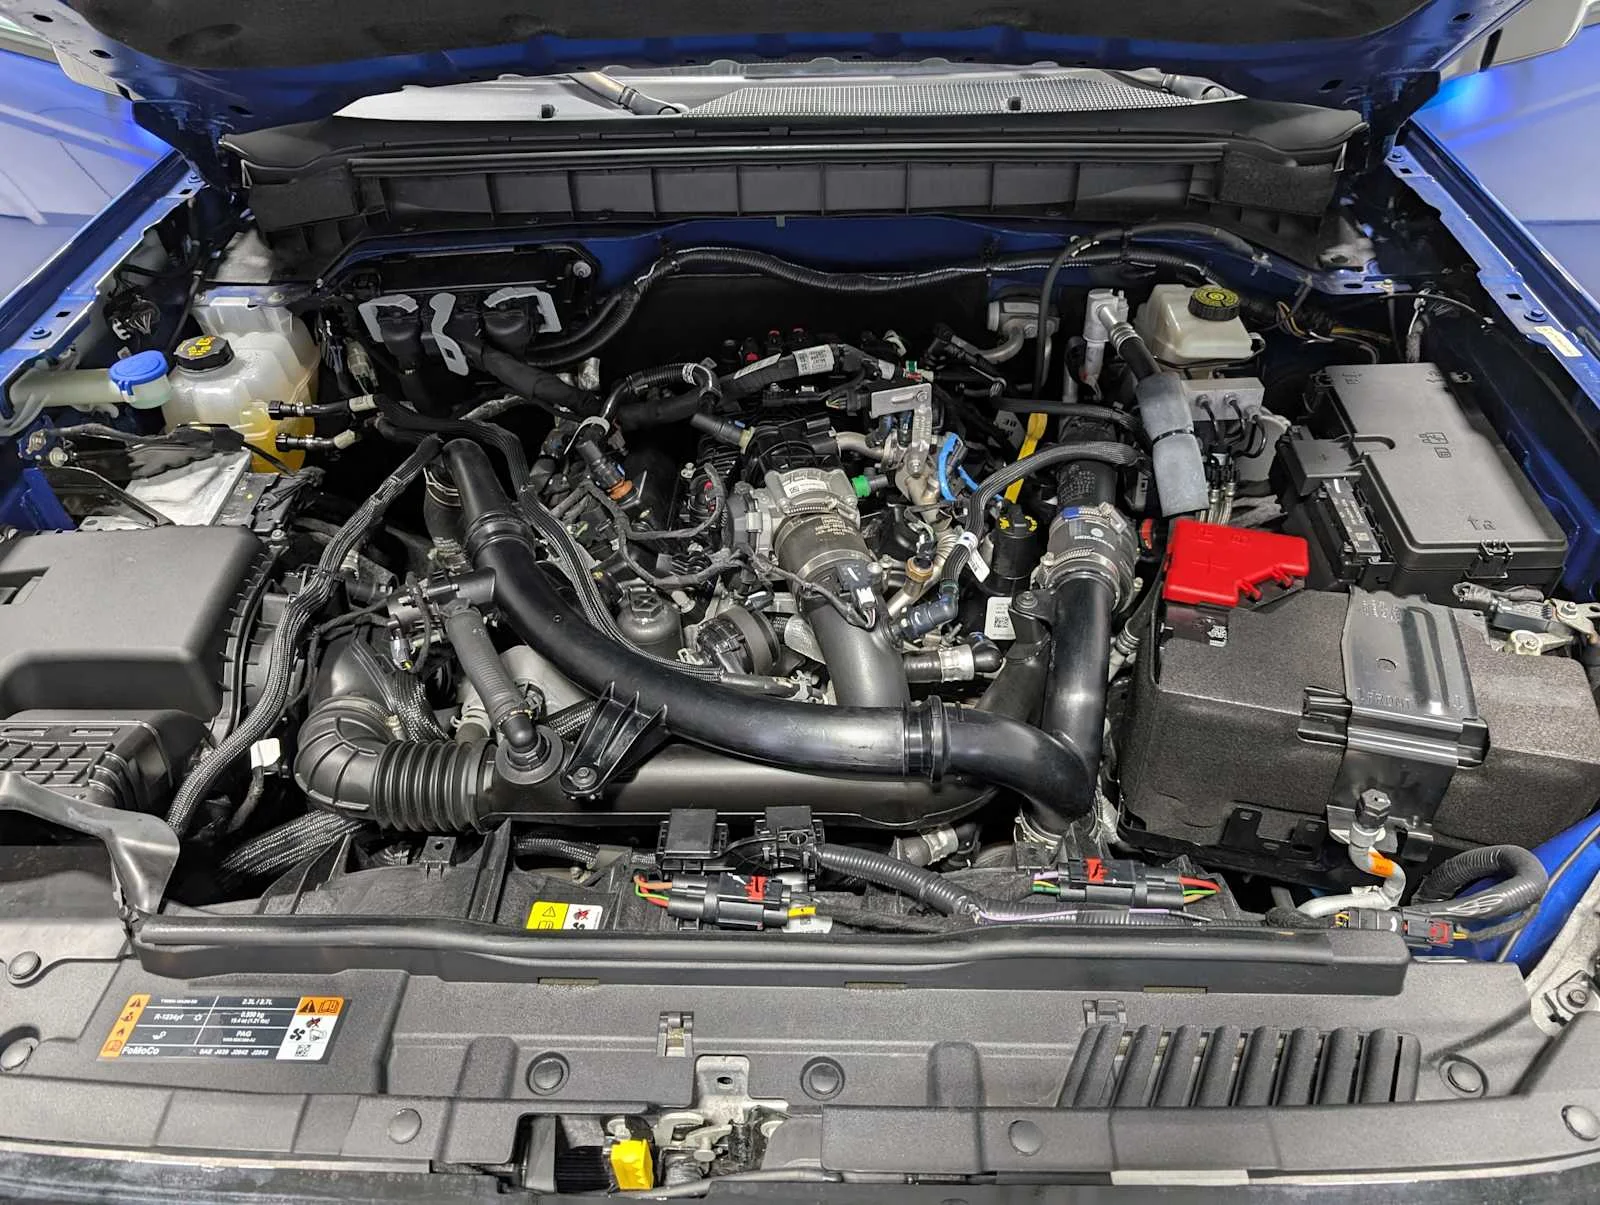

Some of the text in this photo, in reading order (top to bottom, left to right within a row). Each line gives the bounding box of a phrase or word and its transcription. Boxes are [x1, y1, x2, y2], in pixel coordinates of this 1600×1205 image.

[153, 1013, 185, 1022] R-1234yf
[235, 1030, 252, 1038] PAG
[121, 1046, 160, 1056] FoMoCo
